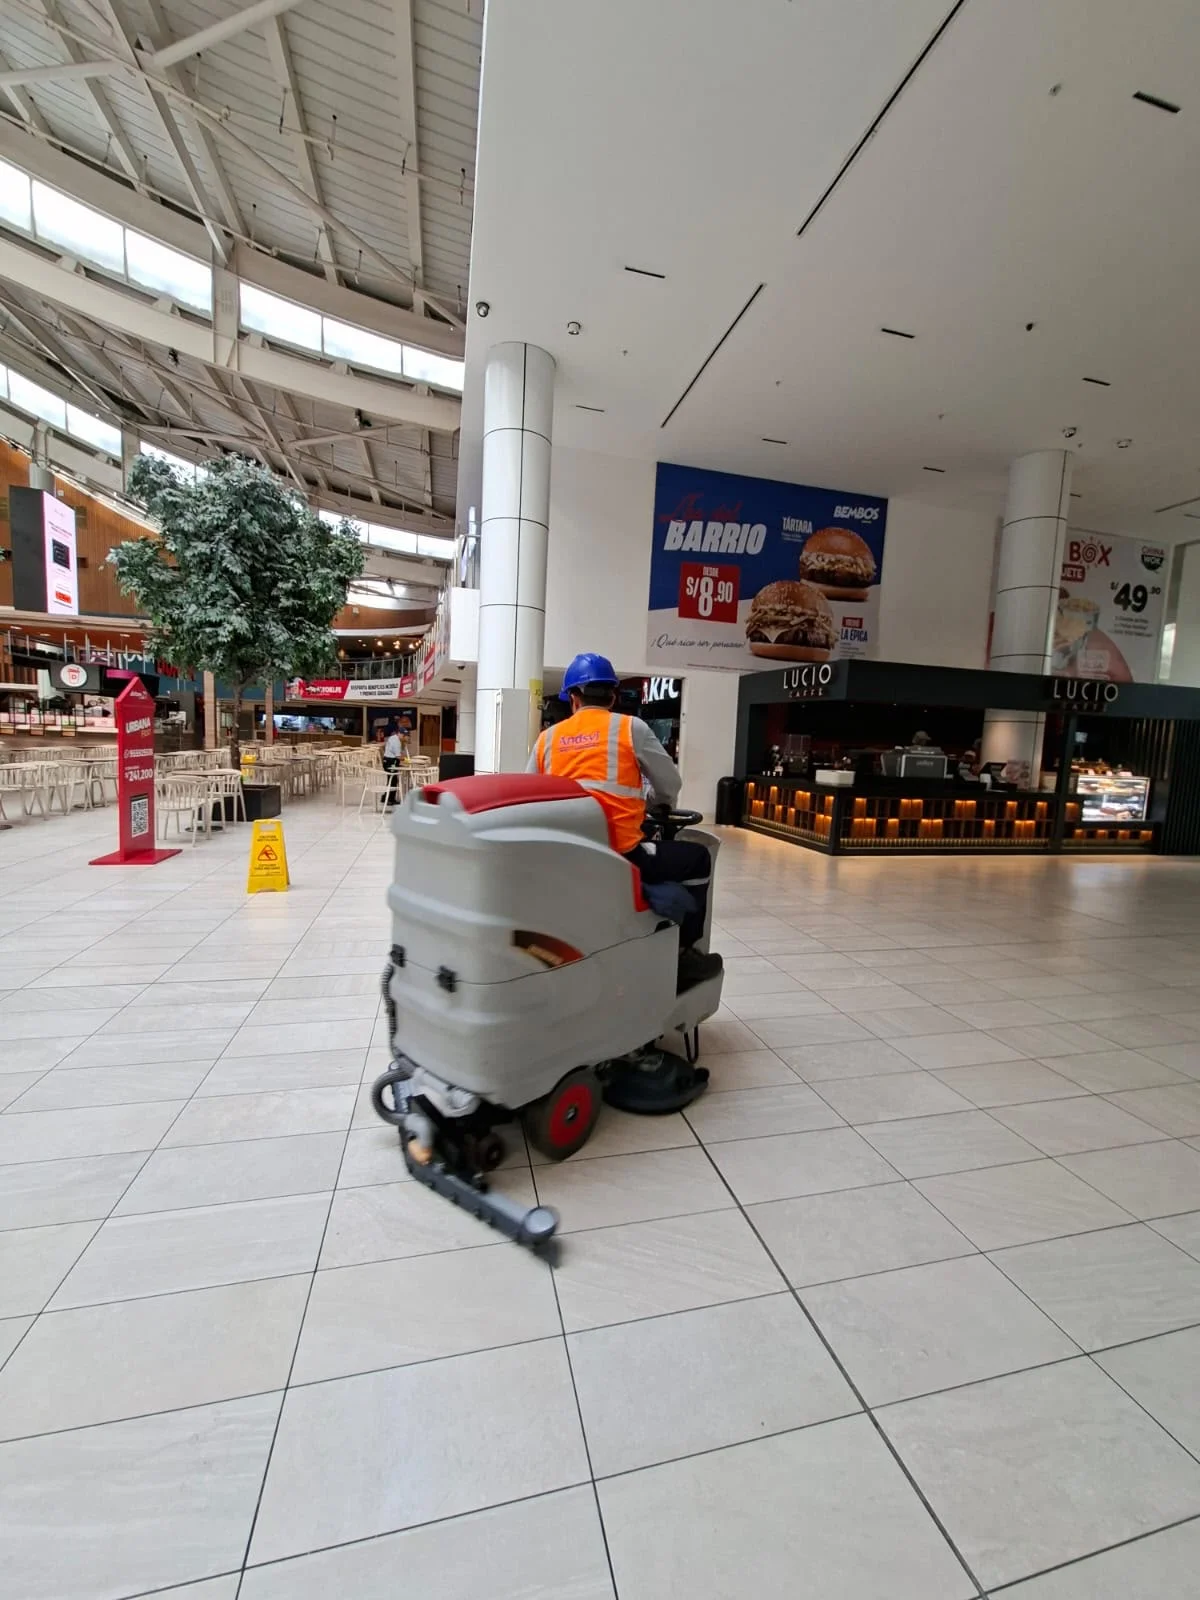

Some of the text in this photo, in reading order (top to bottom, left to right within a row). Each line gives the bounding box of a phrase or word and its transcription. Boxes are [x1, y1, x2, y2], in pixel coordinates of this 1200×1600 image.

[833, 505, 880, 520] BEMBOS
[782, 516, 813, 534] TÁRTARA
[664, 520, 767, 555] BARRIO
[1069, 541, 1112, 567] BOX
[840, 628, 849, 640] LA
[783, 664, 832, 689] LUCIO
[648, 676, 679, 702] KFC
[1053, 679, 1119, 702] LUCIO
